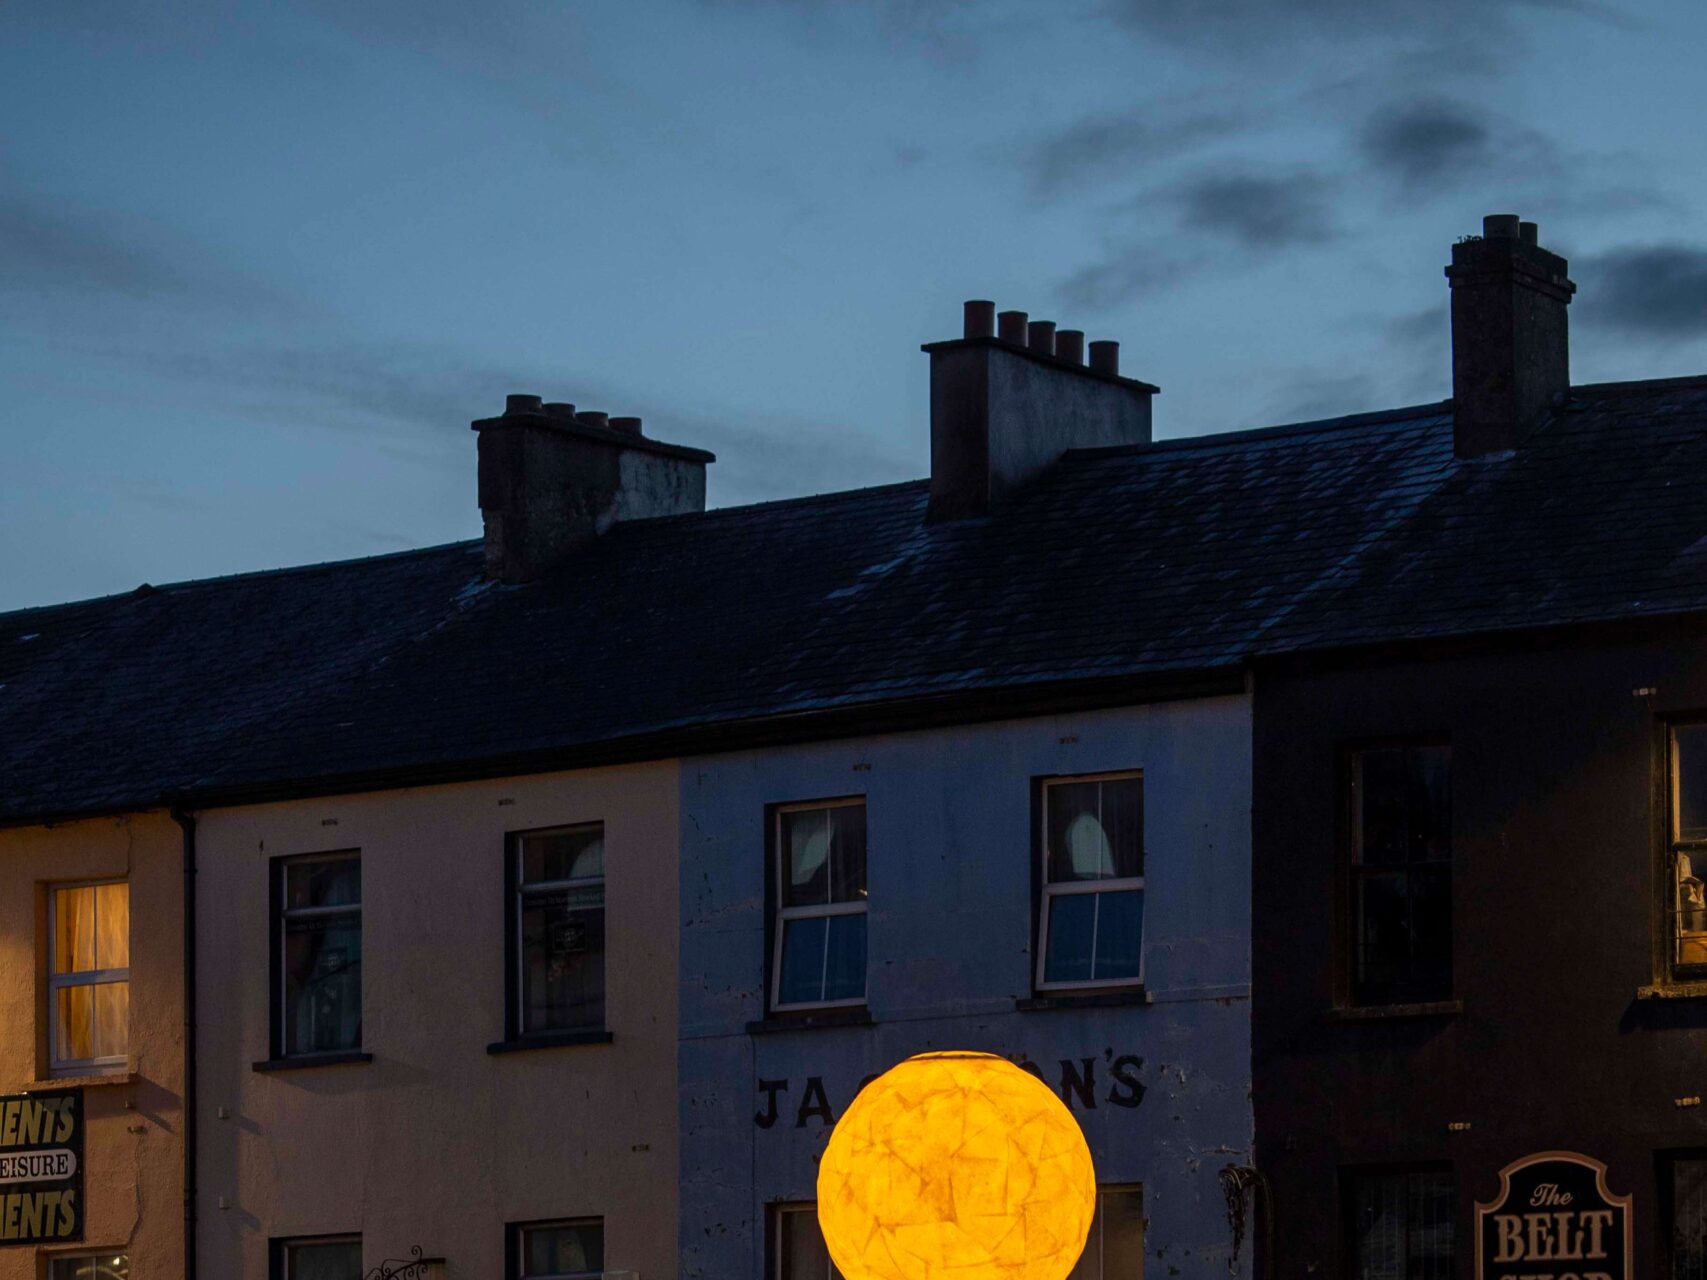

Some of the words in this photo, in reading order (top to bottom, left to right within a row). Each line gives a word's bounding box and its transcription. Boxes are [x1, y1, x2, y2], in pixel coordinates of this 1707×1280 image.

[754, 1047, 1148, 1130] JAN'S
[0, 1096, 75, 1147] ENTS
[0, 1188, 76, 1240] ENTS
[1529, 1182, 1575, 1207] The
[1493, 1210, 1614, 1264] BELT
